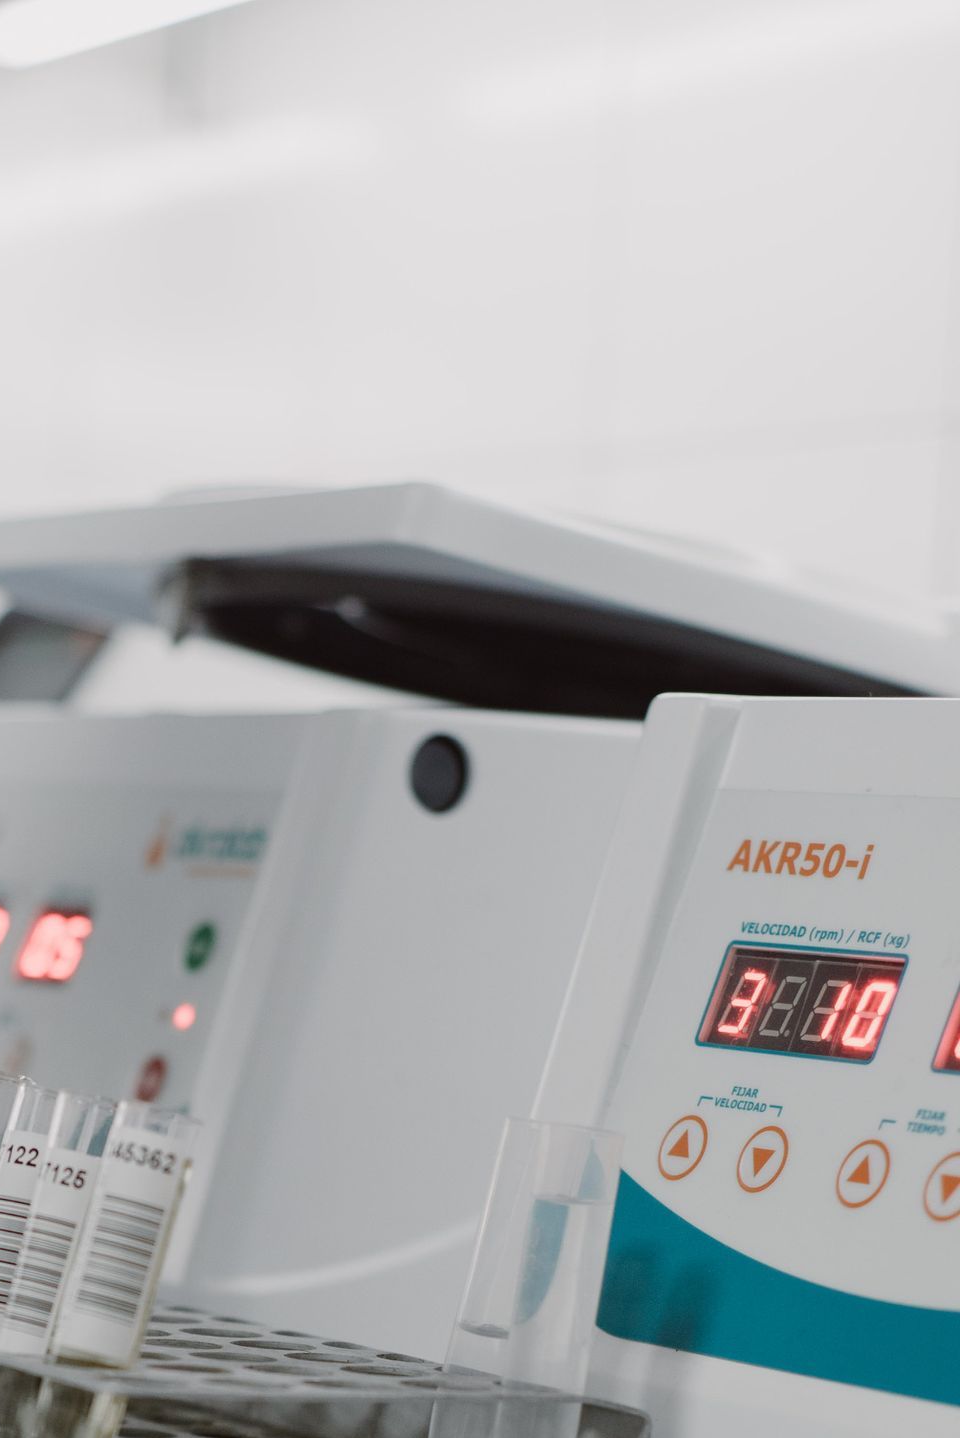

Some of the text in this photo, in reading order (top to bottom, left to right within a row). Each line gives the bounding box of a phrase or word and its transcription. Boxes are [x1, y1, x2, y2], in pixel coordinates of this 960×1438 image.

[726, 838, 875, 880] AKR50-i
[741, 921, 807, 938] VELOCIDAD
[809, 926, 845, 944] (rpm)
[857, 931, 882, 944] RCF
[883, 932, 911, 949] (xg)
[715, 1097, 767, 1113] VELOCIDAD
[731, 1086, 759, 1099] FIJAR
[42, 1161, 87, 1189] 125
